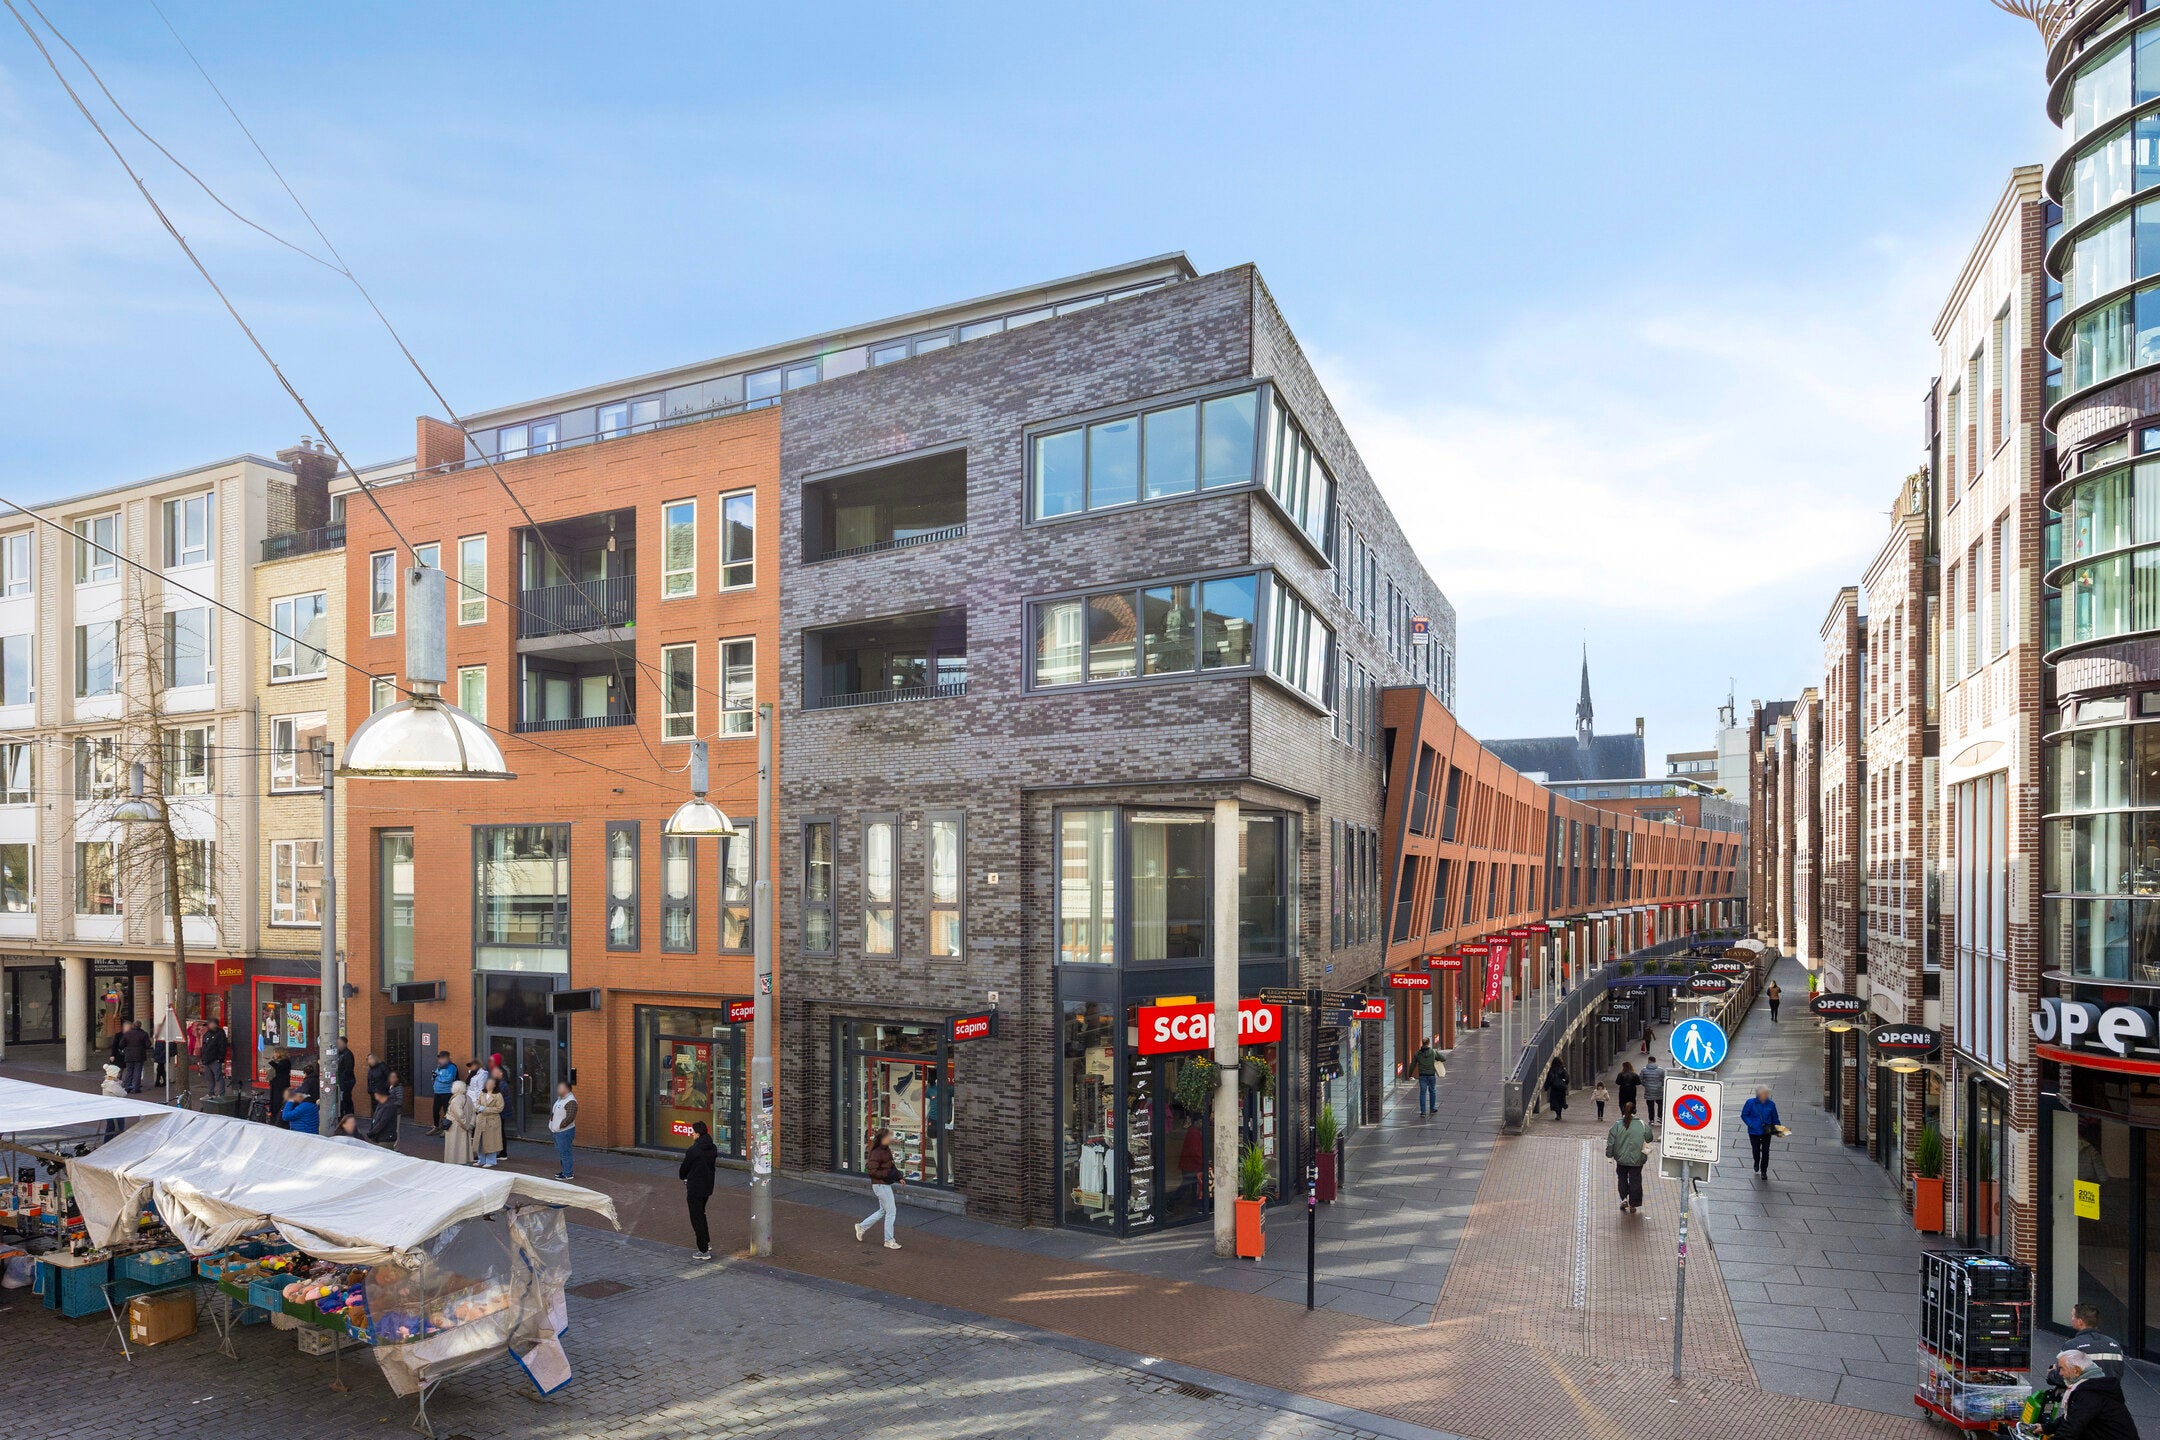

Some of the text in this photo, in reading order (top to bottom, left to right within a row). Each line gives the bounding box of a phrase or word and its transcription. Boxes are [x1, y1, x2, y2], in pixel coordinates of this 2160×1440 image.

[1431, 959, 1460, 967] scapino
[1491, 946, 1502, 996] pipoos
[1393, 977, 1428, 986] scapino
[955, 1021, 987, 1036] scapino
[1682, 1084, 1705, 1093] ZONE
[673, 1124, 694, 1136] scap
